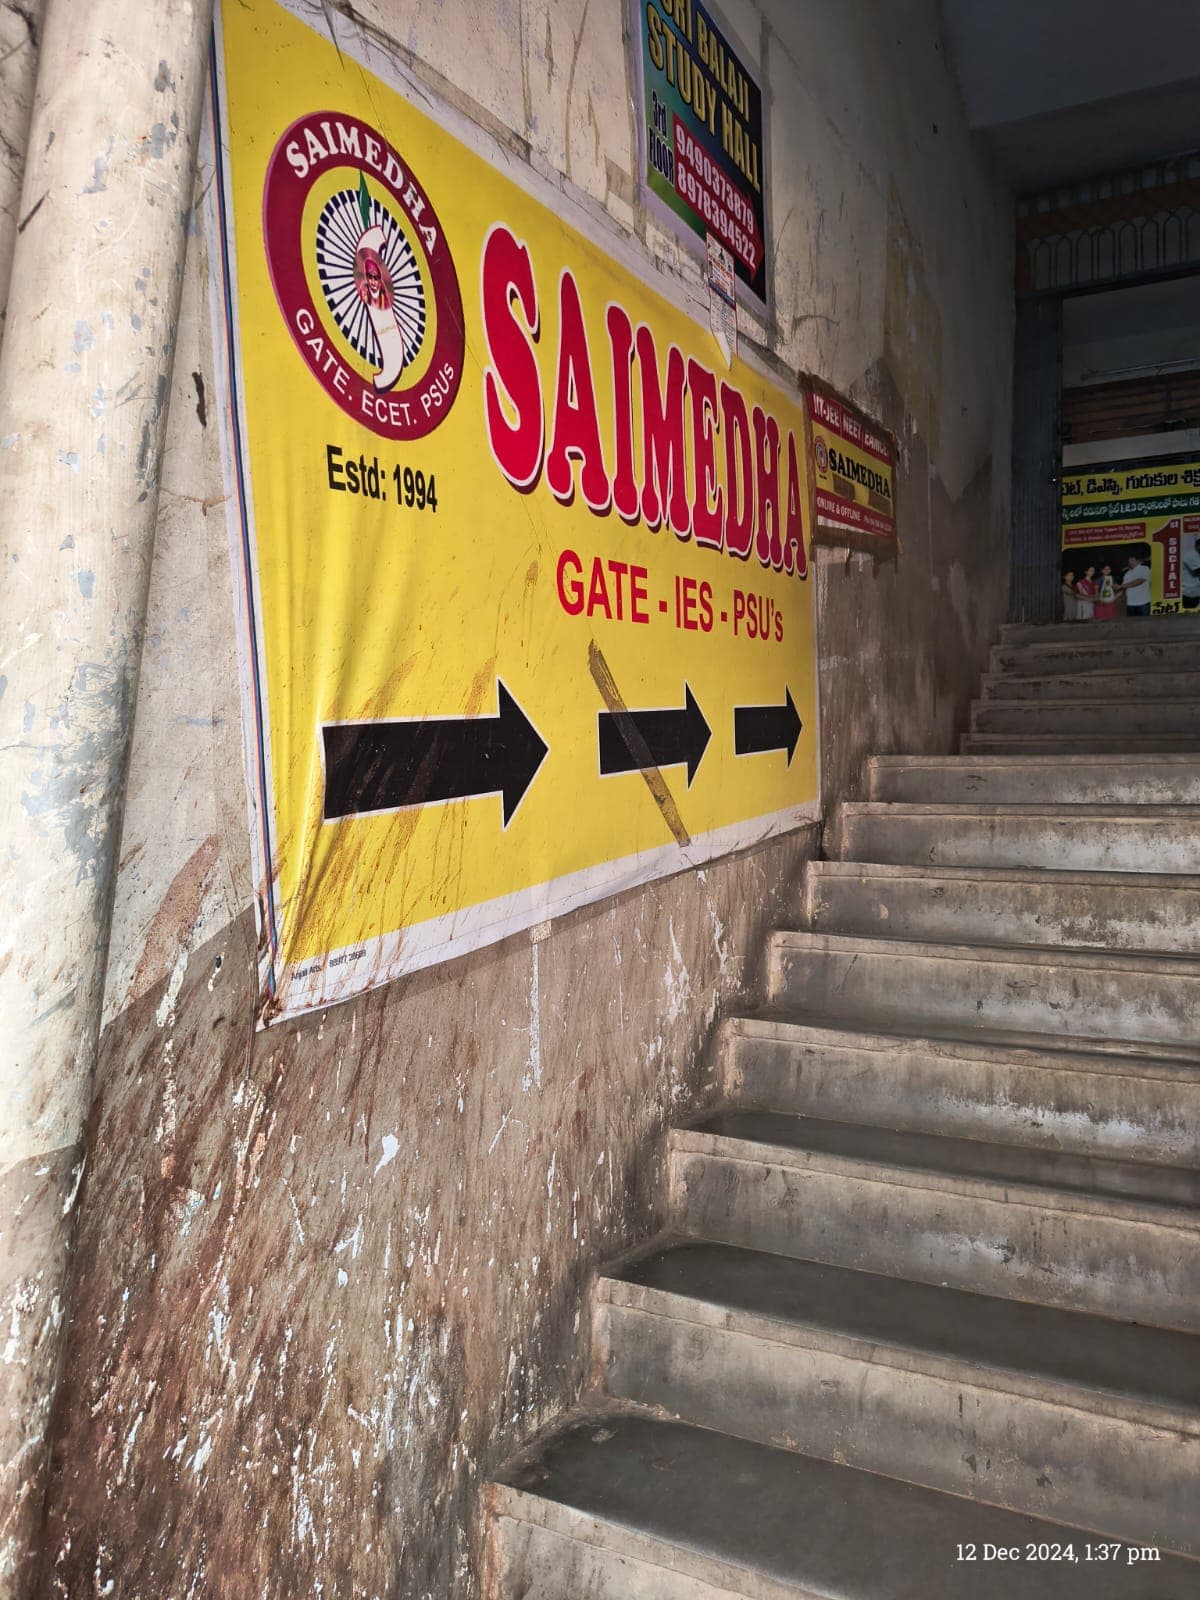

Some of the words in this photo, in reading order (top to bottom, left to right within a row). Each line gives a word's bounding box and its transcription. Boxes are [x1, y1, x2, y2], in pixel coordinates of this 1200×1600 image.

[647, 3, 717, 136] STUDY
[721, 102, 761, 194] HALL
[652, 88, 668, 140] 3rd
[696, 11, 750, 122] BALAJI
[286, 121, 437, 256] SAIMEDHA
[648, 124, 675, 187] FLOOR
[675, 124, 755, 235] 9490373879
[677, 162, 756, 269] 8978394522
[420, 362, 455, 419] PSUs
[481, 221, 809, 578] SAIMEDHA
[326, 444, 387, 501] Estd:
[393, 464, 438, 513] 1994
[829, 448, 891, 498] SAIMEDHA
[556, 549, 650, 624] GATE
[675, 575, 714, 632] IES
[733, 589, 784, 643] PSU's
